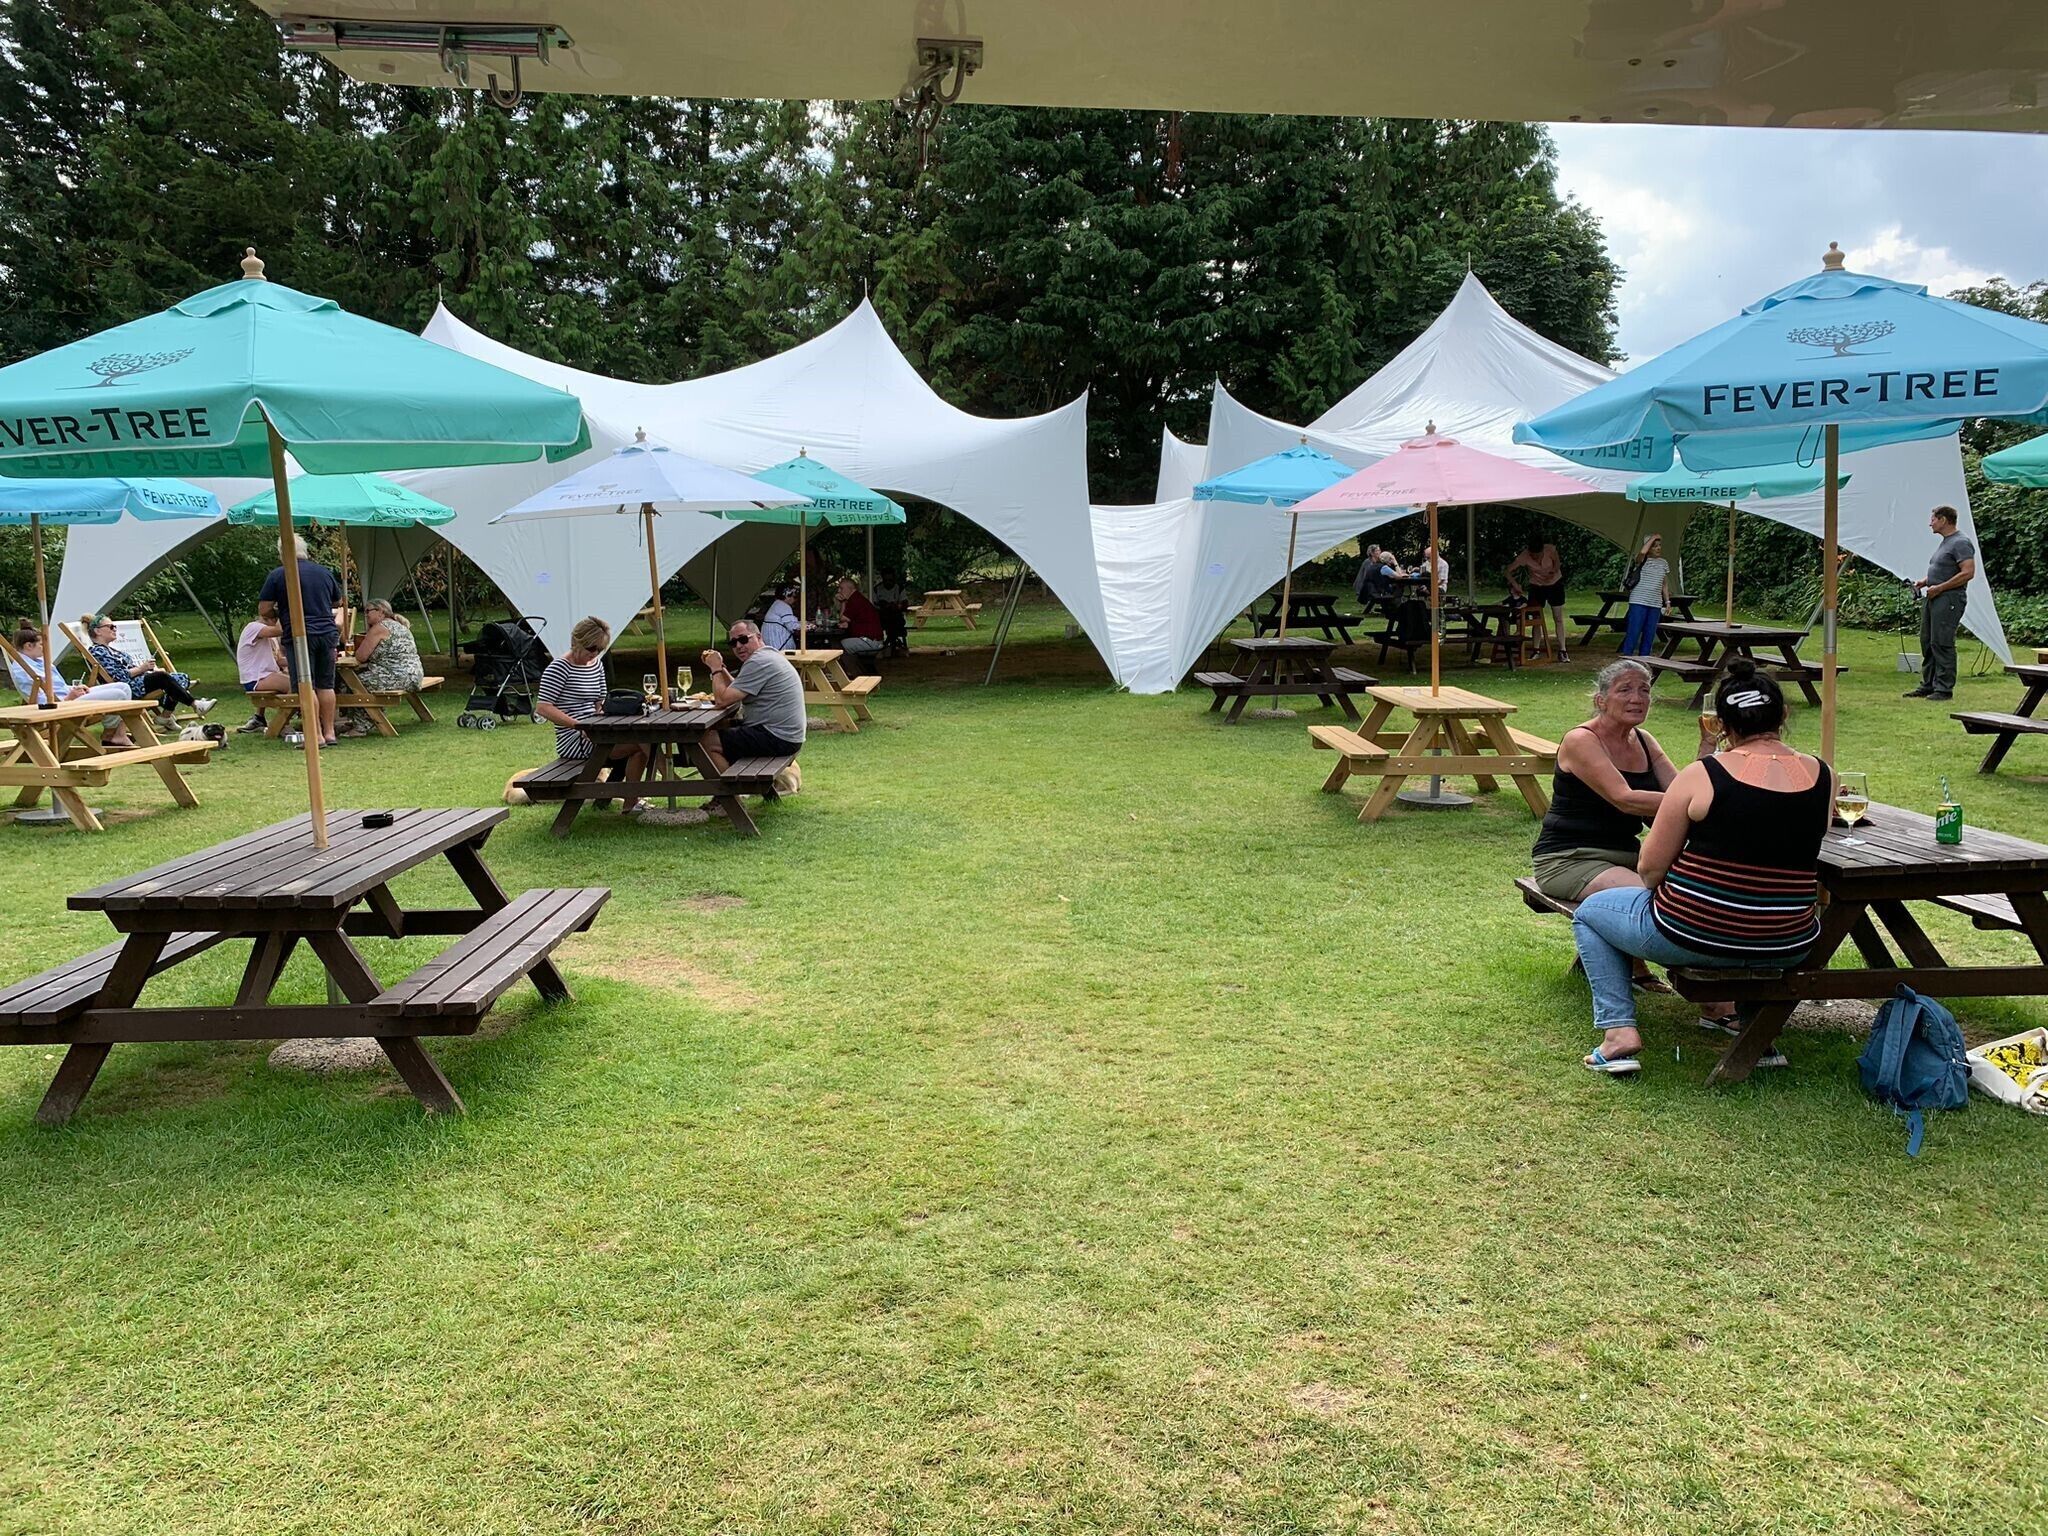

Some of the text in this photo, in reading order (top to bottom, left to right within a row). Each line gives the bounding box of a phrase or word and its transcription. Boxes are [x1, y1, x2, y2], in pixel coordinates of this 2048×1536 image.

[1703, 368, 2000, 415] FEVER-TREE
[0, 408, 211, 448] VER-TREE
[142, 488, 208, 508] FEVER-TREE
[1653, 486, 1737, 498] FEVER-TREE
[794, 499, 874, 511] VER-TREE
[1936, 810, 1958, 828] rite
